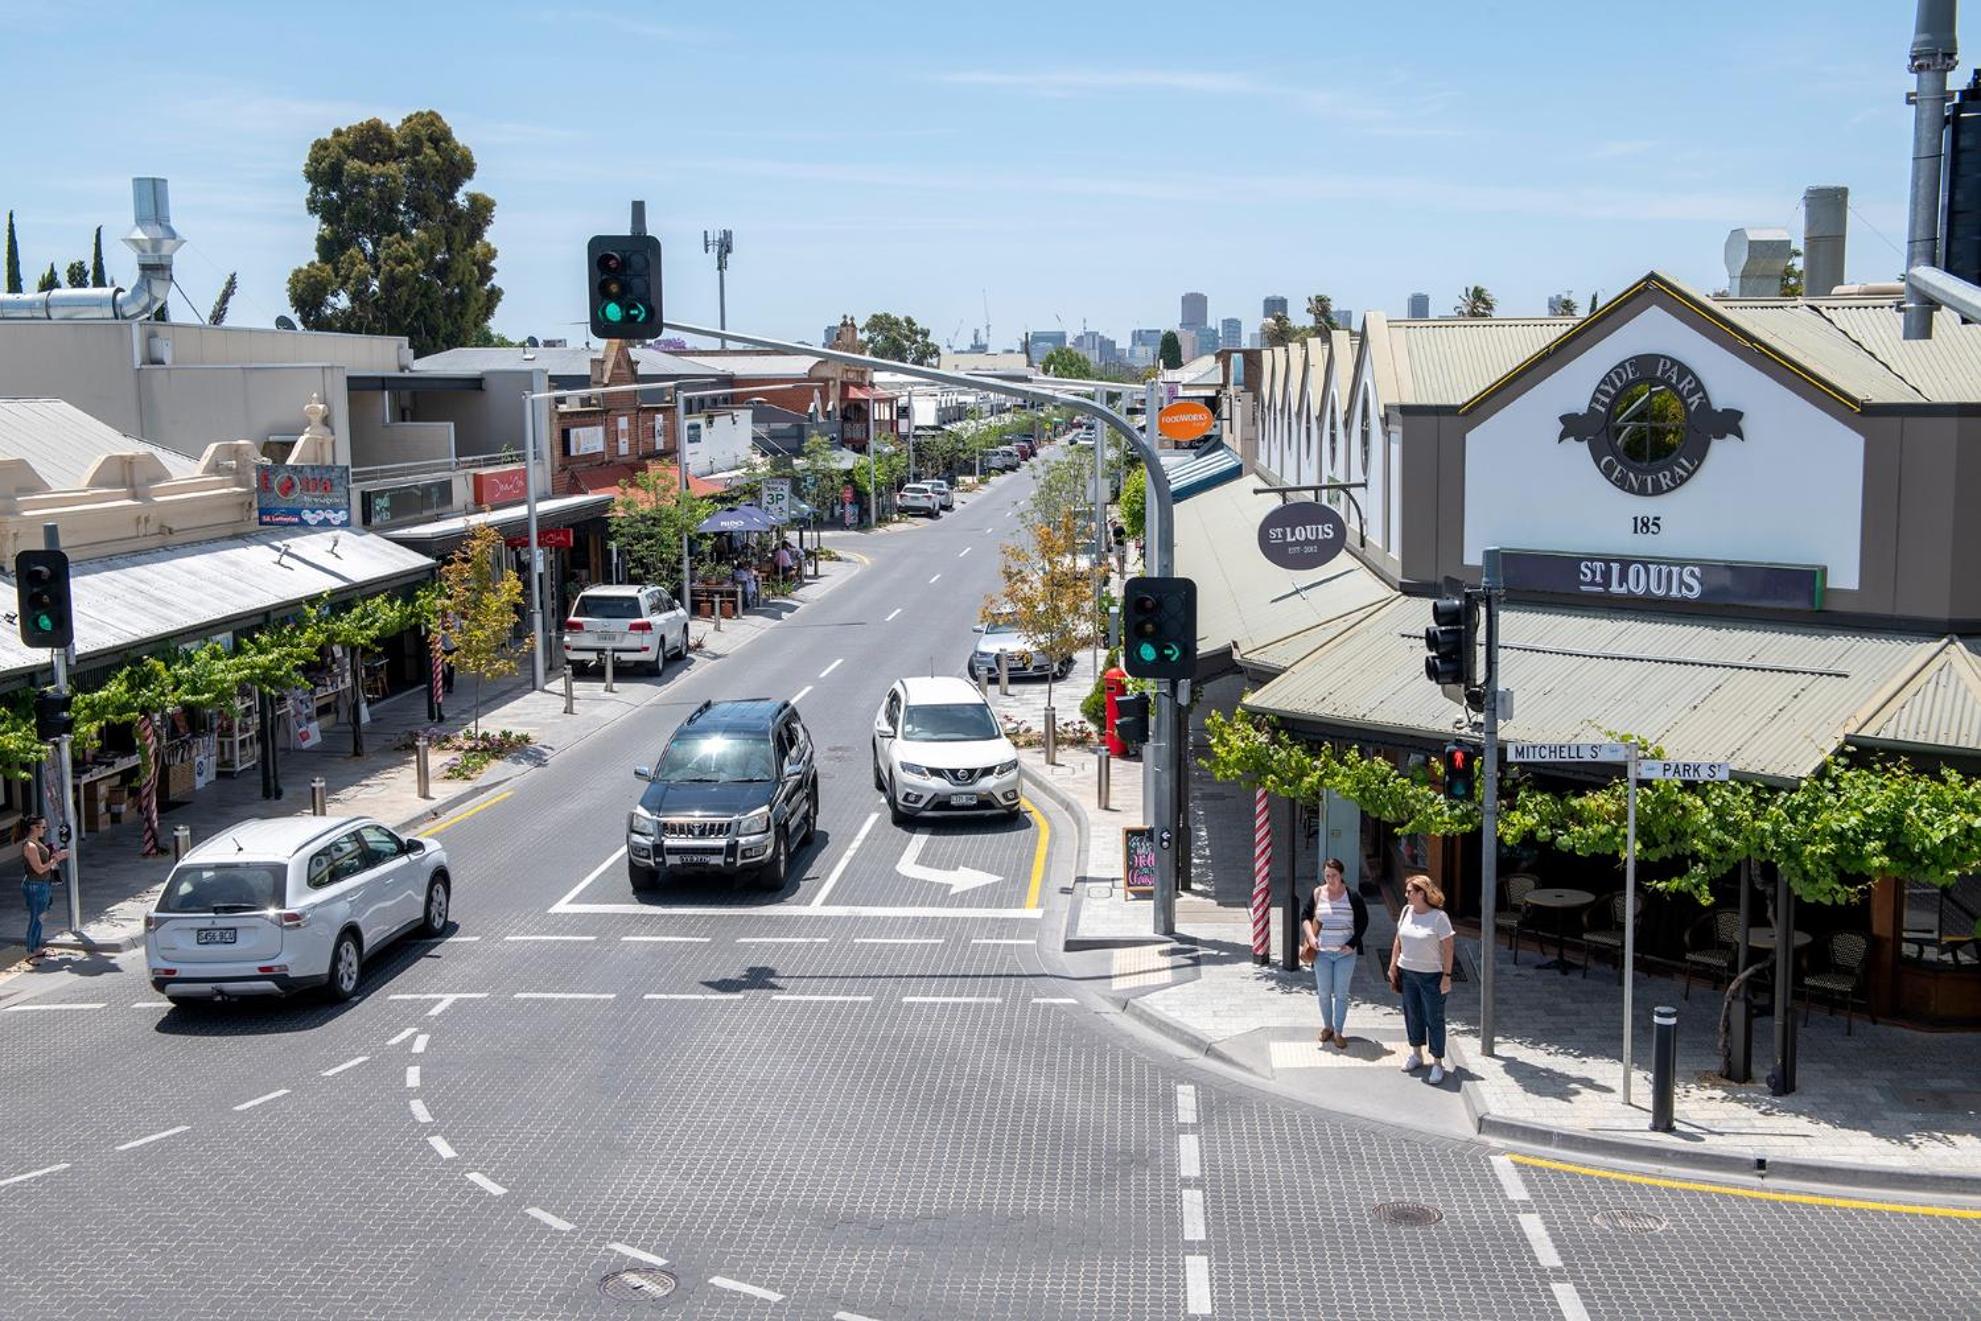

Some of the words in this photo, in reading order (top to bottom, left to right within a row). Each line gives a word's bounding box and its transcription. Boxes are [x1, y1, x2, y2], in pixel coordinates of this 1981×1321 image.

[1590, 359, 1640, 413] HYDE
[1656, 358, 1706, 412] PARK
[1600, 455, 1698, 494] CENTRAL
[766, 493, 785, 505] 3P
[1268, 528, 1283, 540] ST
[1285, 524, 1335, 542] LOUIS
[1632, 516, 1661, 534] 185
[1580, 561, 1605, 583] ST
[1609, 562, 1702, 599] LOUIS
[1514, 745, 1584, 759] MITCHELL
[1662, 763, 1701, 778] PARK
